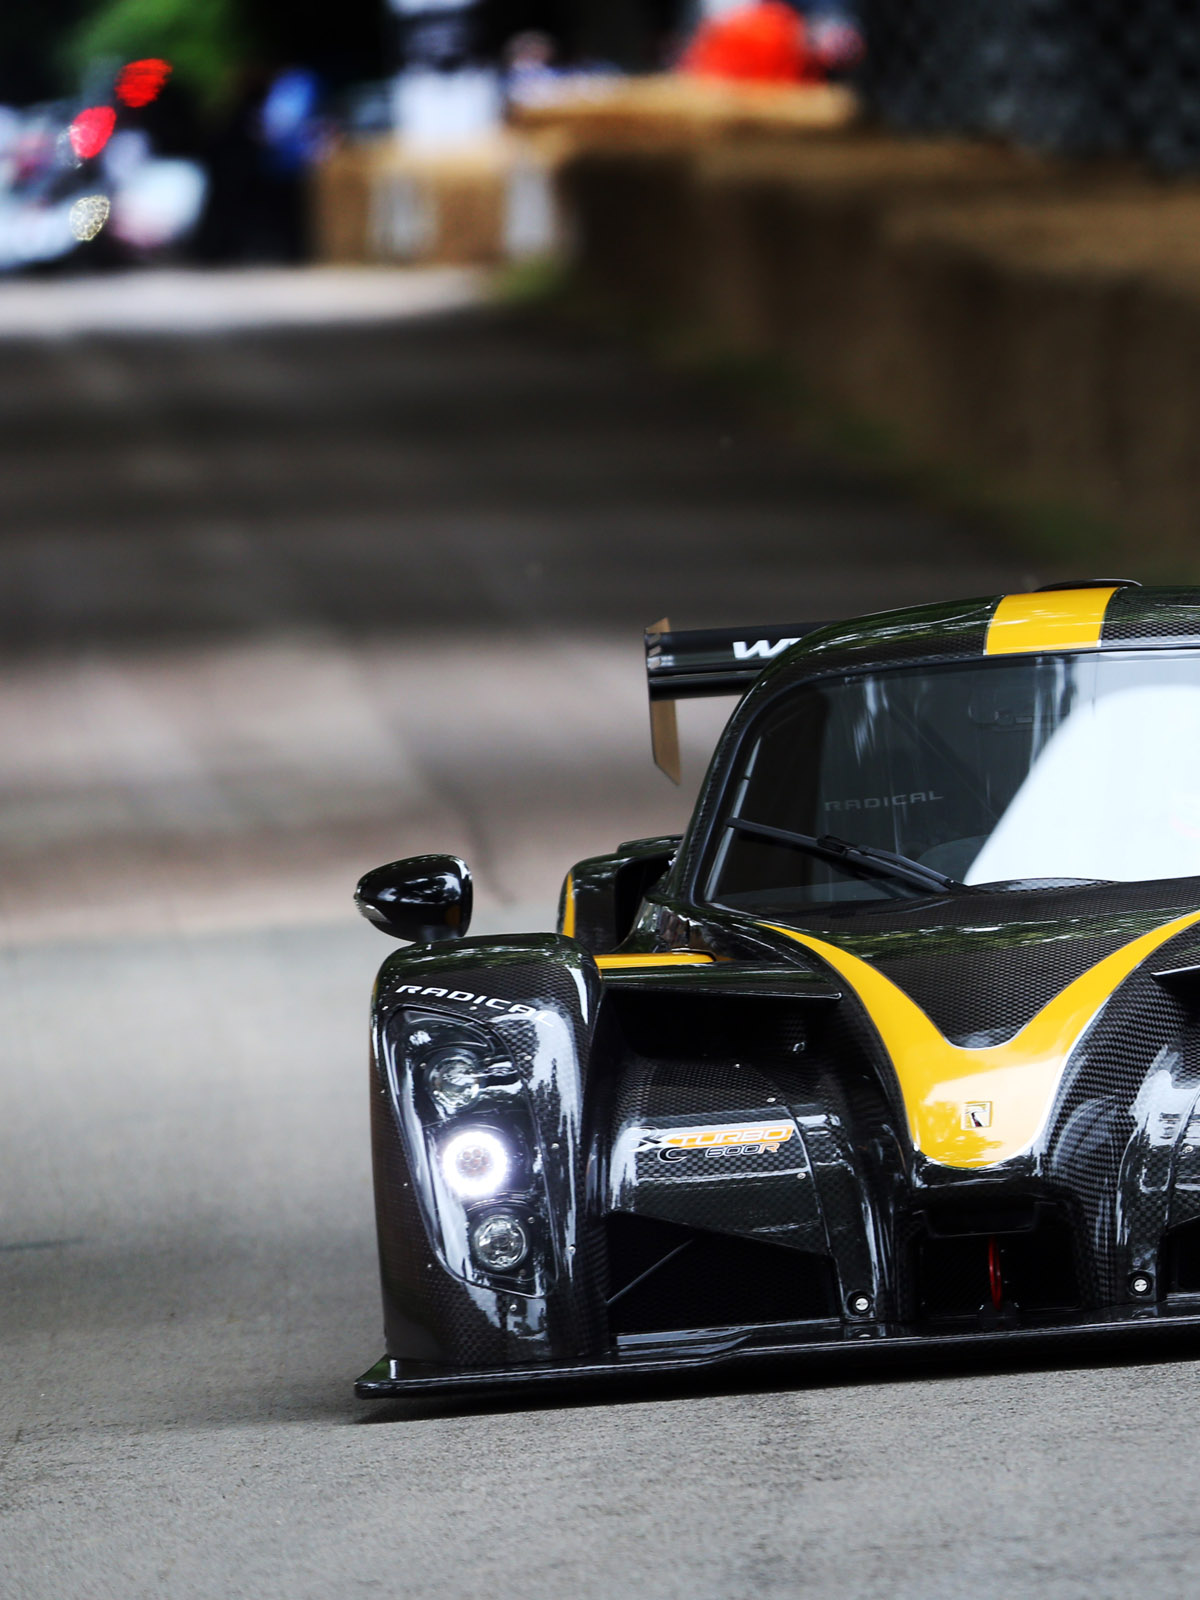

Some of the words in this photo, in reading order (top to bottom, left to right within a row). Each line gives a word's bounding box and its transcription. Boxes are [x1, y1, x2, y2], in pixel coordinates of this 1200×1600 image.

[824, 791, 944, 811] RADICAL
[395, 985, 554, 1027] RADICAL
[676, 1127, 790, 1147] TURBO
[705, 1142, 781, 1158] 600R
